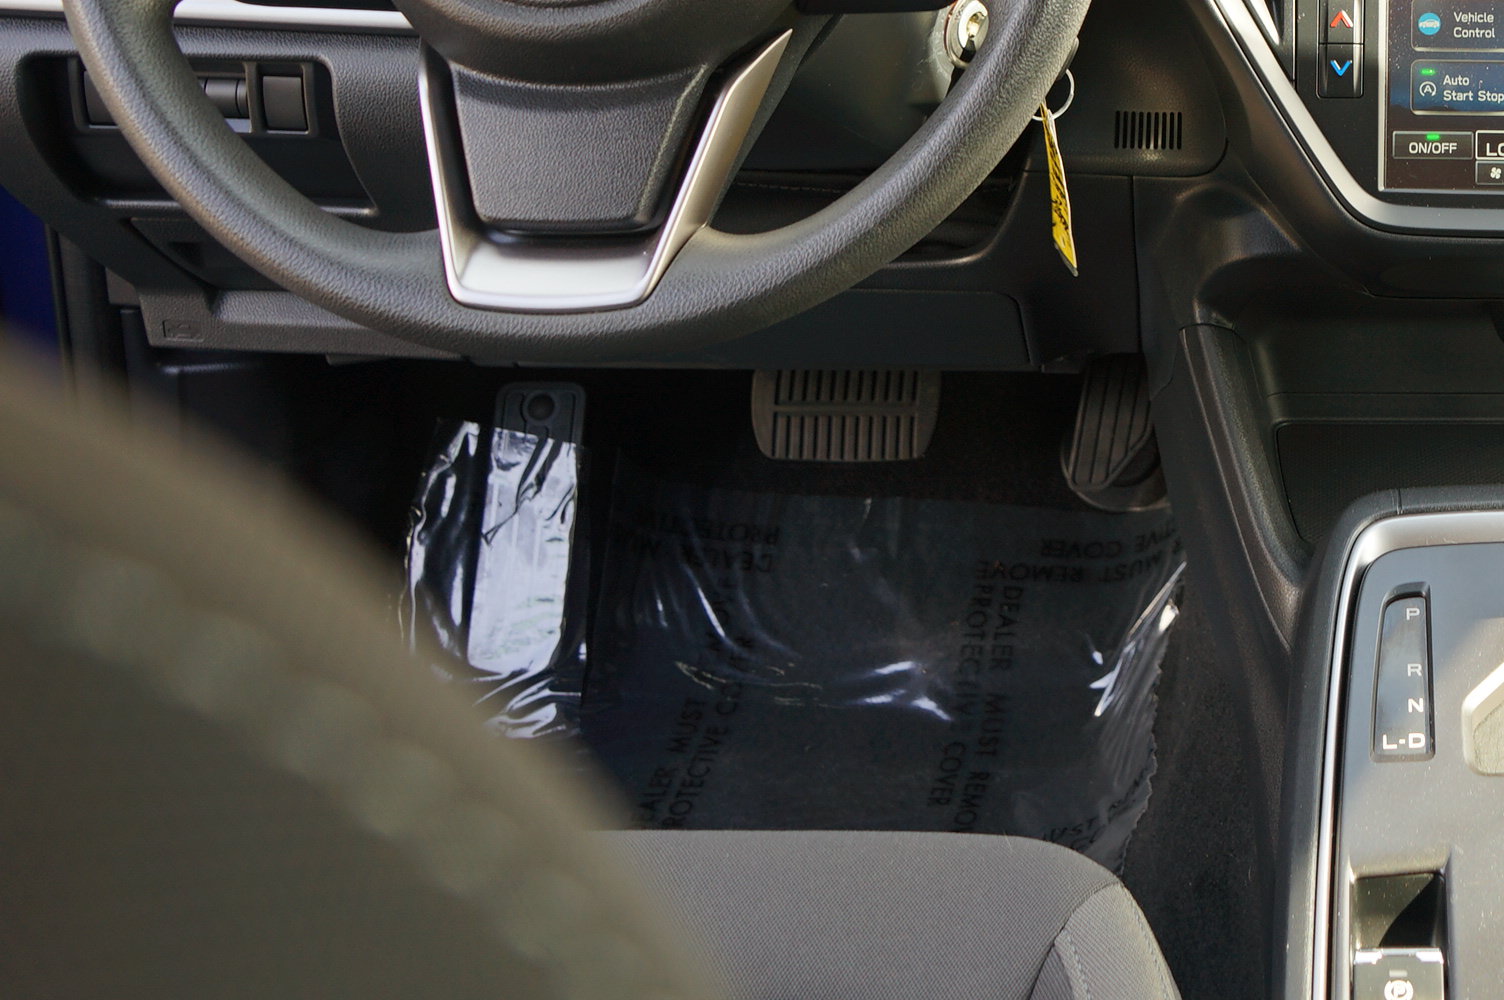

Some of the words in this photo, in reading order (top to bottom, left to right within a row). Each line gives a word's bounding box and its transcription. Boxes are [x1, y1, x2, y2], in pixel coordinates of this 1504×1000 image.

[1453, 11, 1494, 24] Vehicle
[1453, 27, 1495, 39] Control
[1442, 75, 1470, 87] Auto
[1442, 90, 1473, 102] Start
[1477, 90, 1504, 104] Stop
[1408, 142, 1458, 155] ON/OFF
[1040, 538, 1123, 560] COVER
[1406, 607, 1420, 620] P
[989, 585, 1024, 671] DEALER
[1407, 663, 1423, 677] R
[1408, 698, 1424, 713] N
[975, 692, 1012, 758] MUST
[661, 725, 730, 830] ROTECTIVE
[926, 740, 968, 808] COVER
[950, 771, 993, 833] REMO
